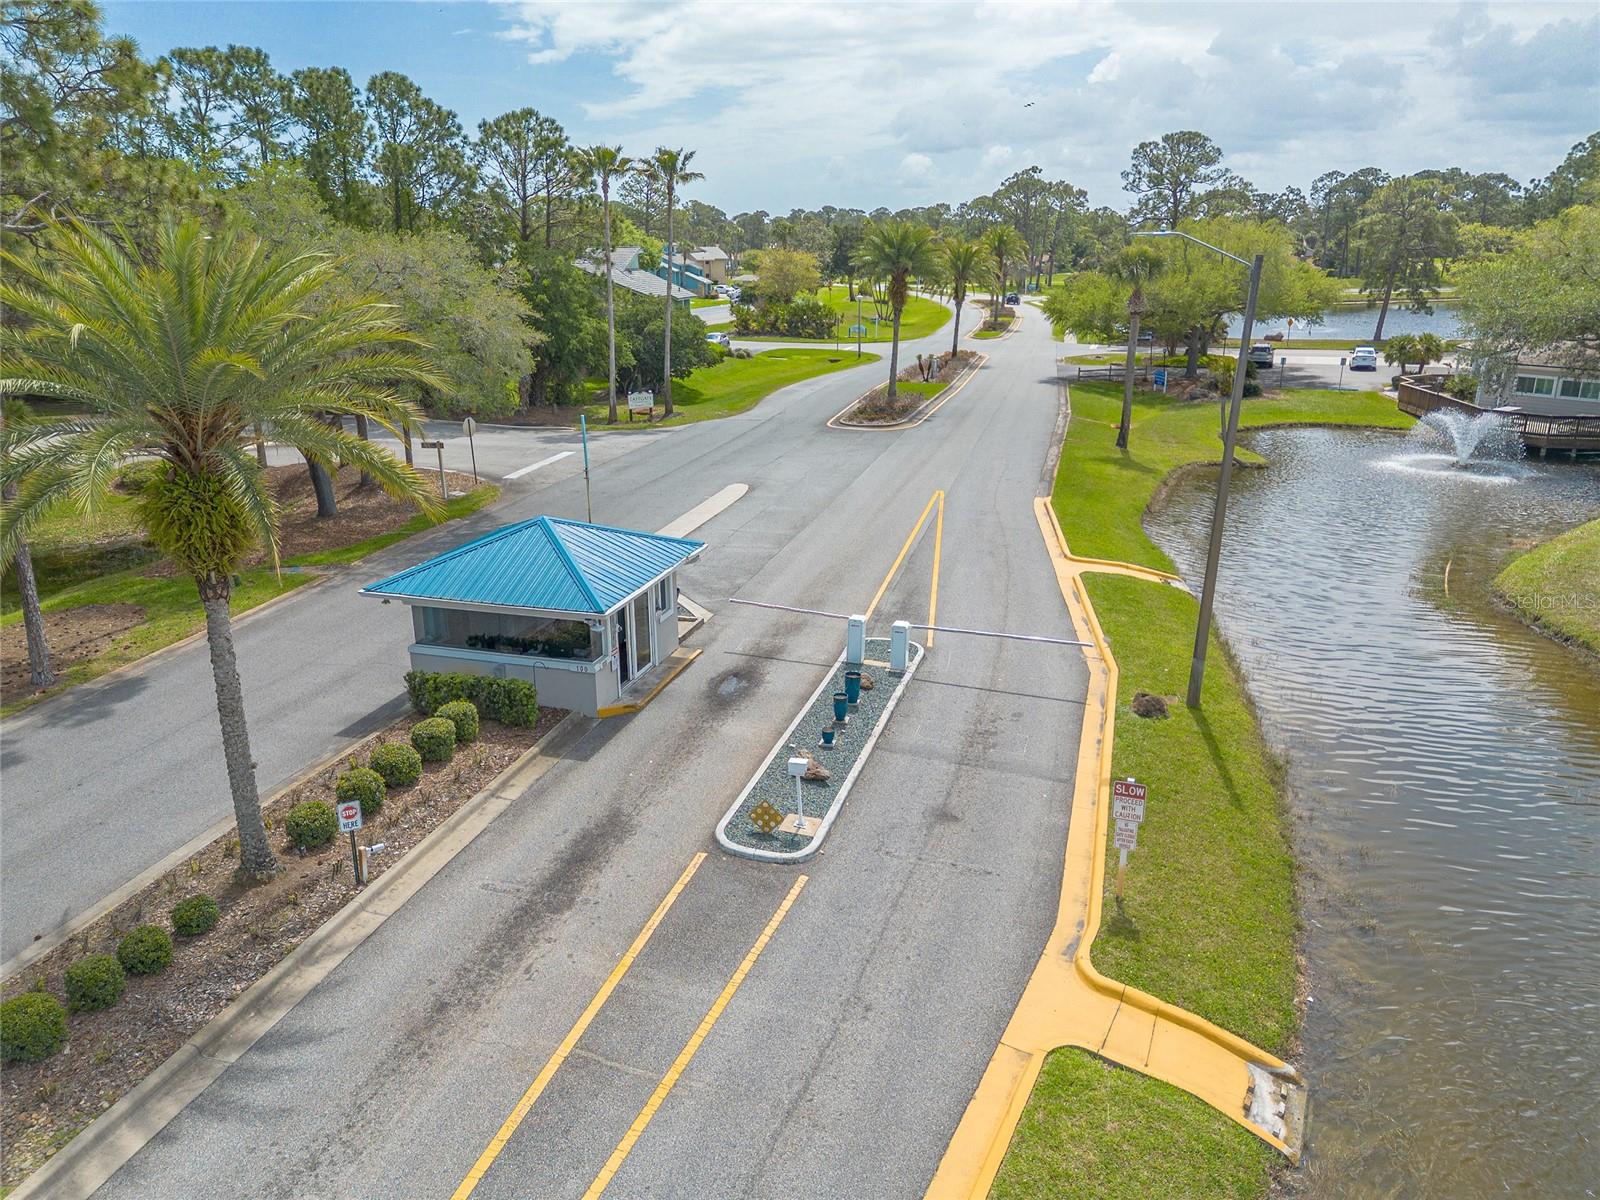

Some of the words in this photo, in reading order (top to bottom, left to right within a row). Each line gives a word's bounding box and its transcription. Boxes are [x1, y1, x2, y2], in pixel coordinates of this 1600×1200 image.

[576, 665, 588, 673] 100
[1116, 784, 1145, 796] SLOW
[1115, 796, 1143, 807] PROCEED
[1121, 804, 1136, 812] WITH
[342, 809, 357, 818] STOP
[1114, 811, 1142, 821] CAUTION
[342, 820, 359, 829] HERE
